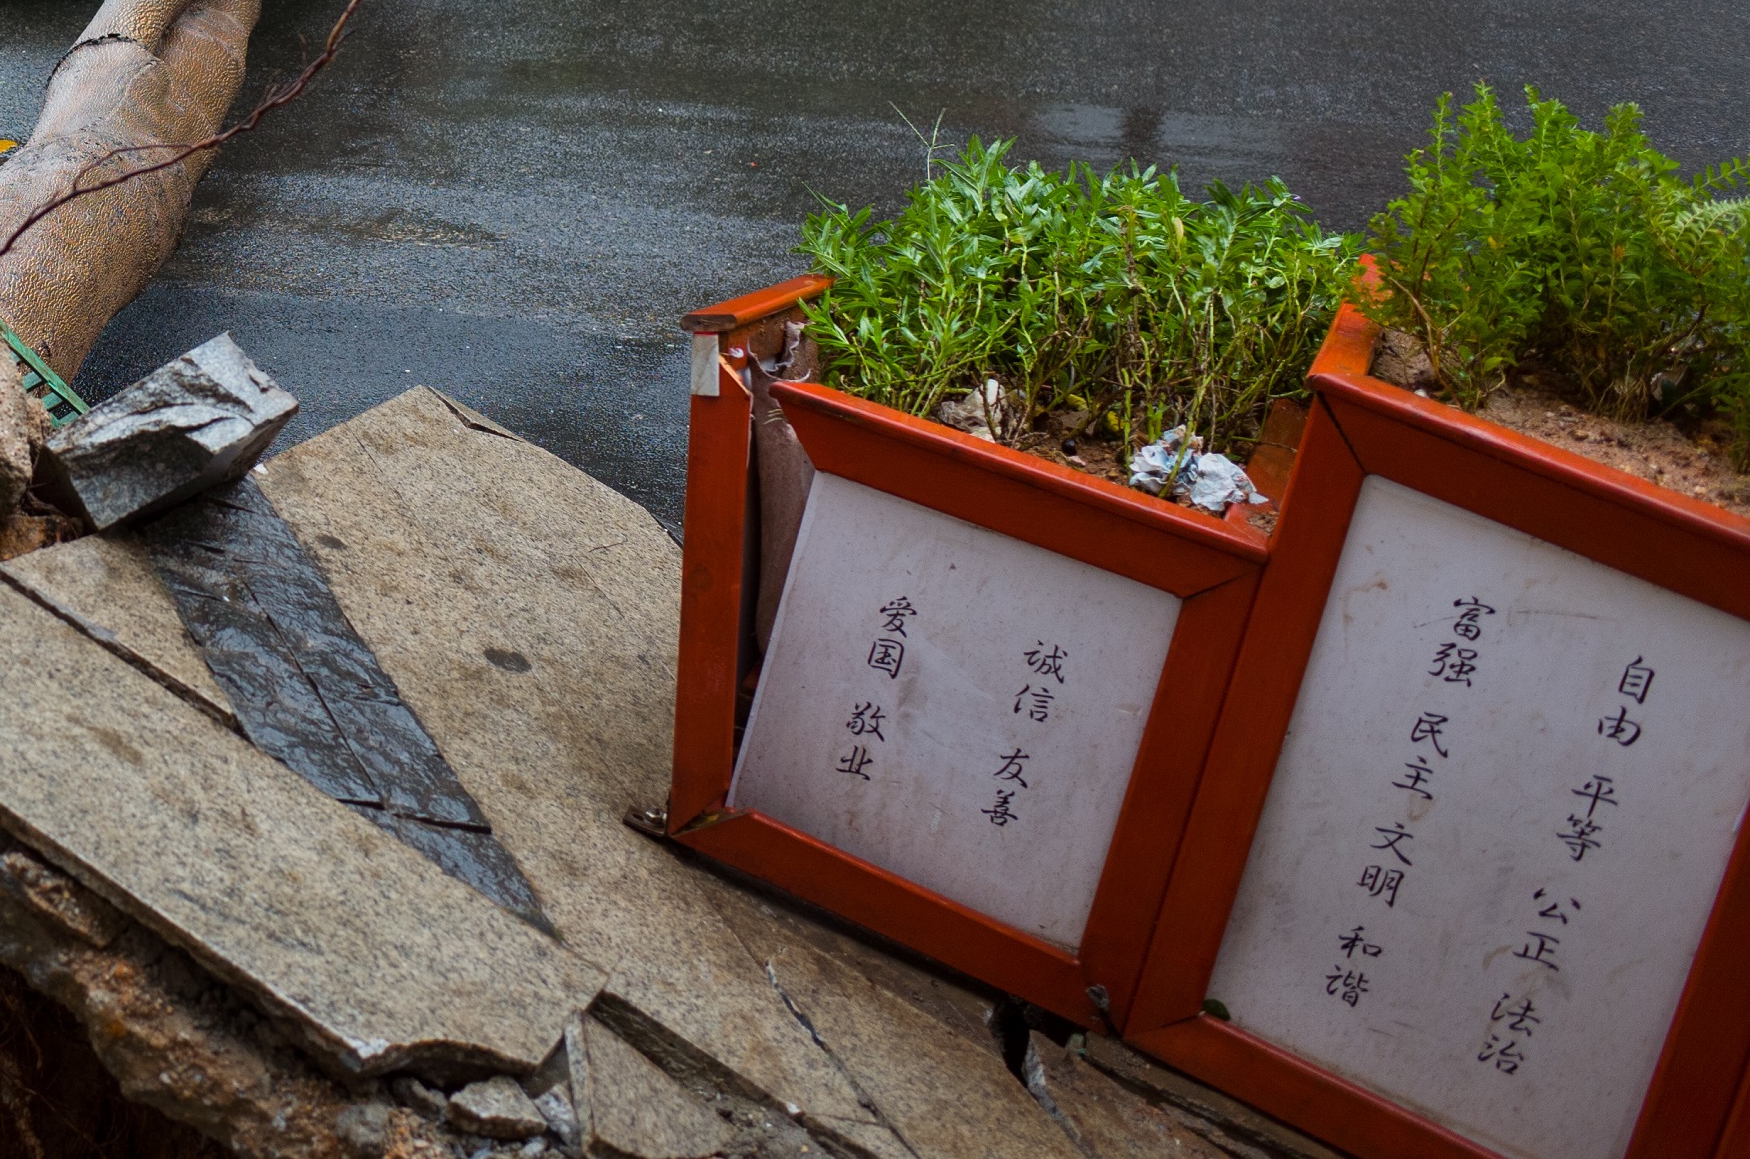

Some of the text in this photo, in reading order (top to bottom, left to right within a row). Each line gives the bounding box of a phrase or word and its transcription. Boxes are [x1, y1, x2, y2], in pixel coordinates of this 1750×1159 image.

[836, 597, 916, 780] 爱国 敬业
[981, 641, 1067, 826] 诚信 友善
[1326, 597, 1495, 1007] 富强 民主 文明 和谐
[1478, 657, 1654, 1074] 自由 平等 公正 法治
